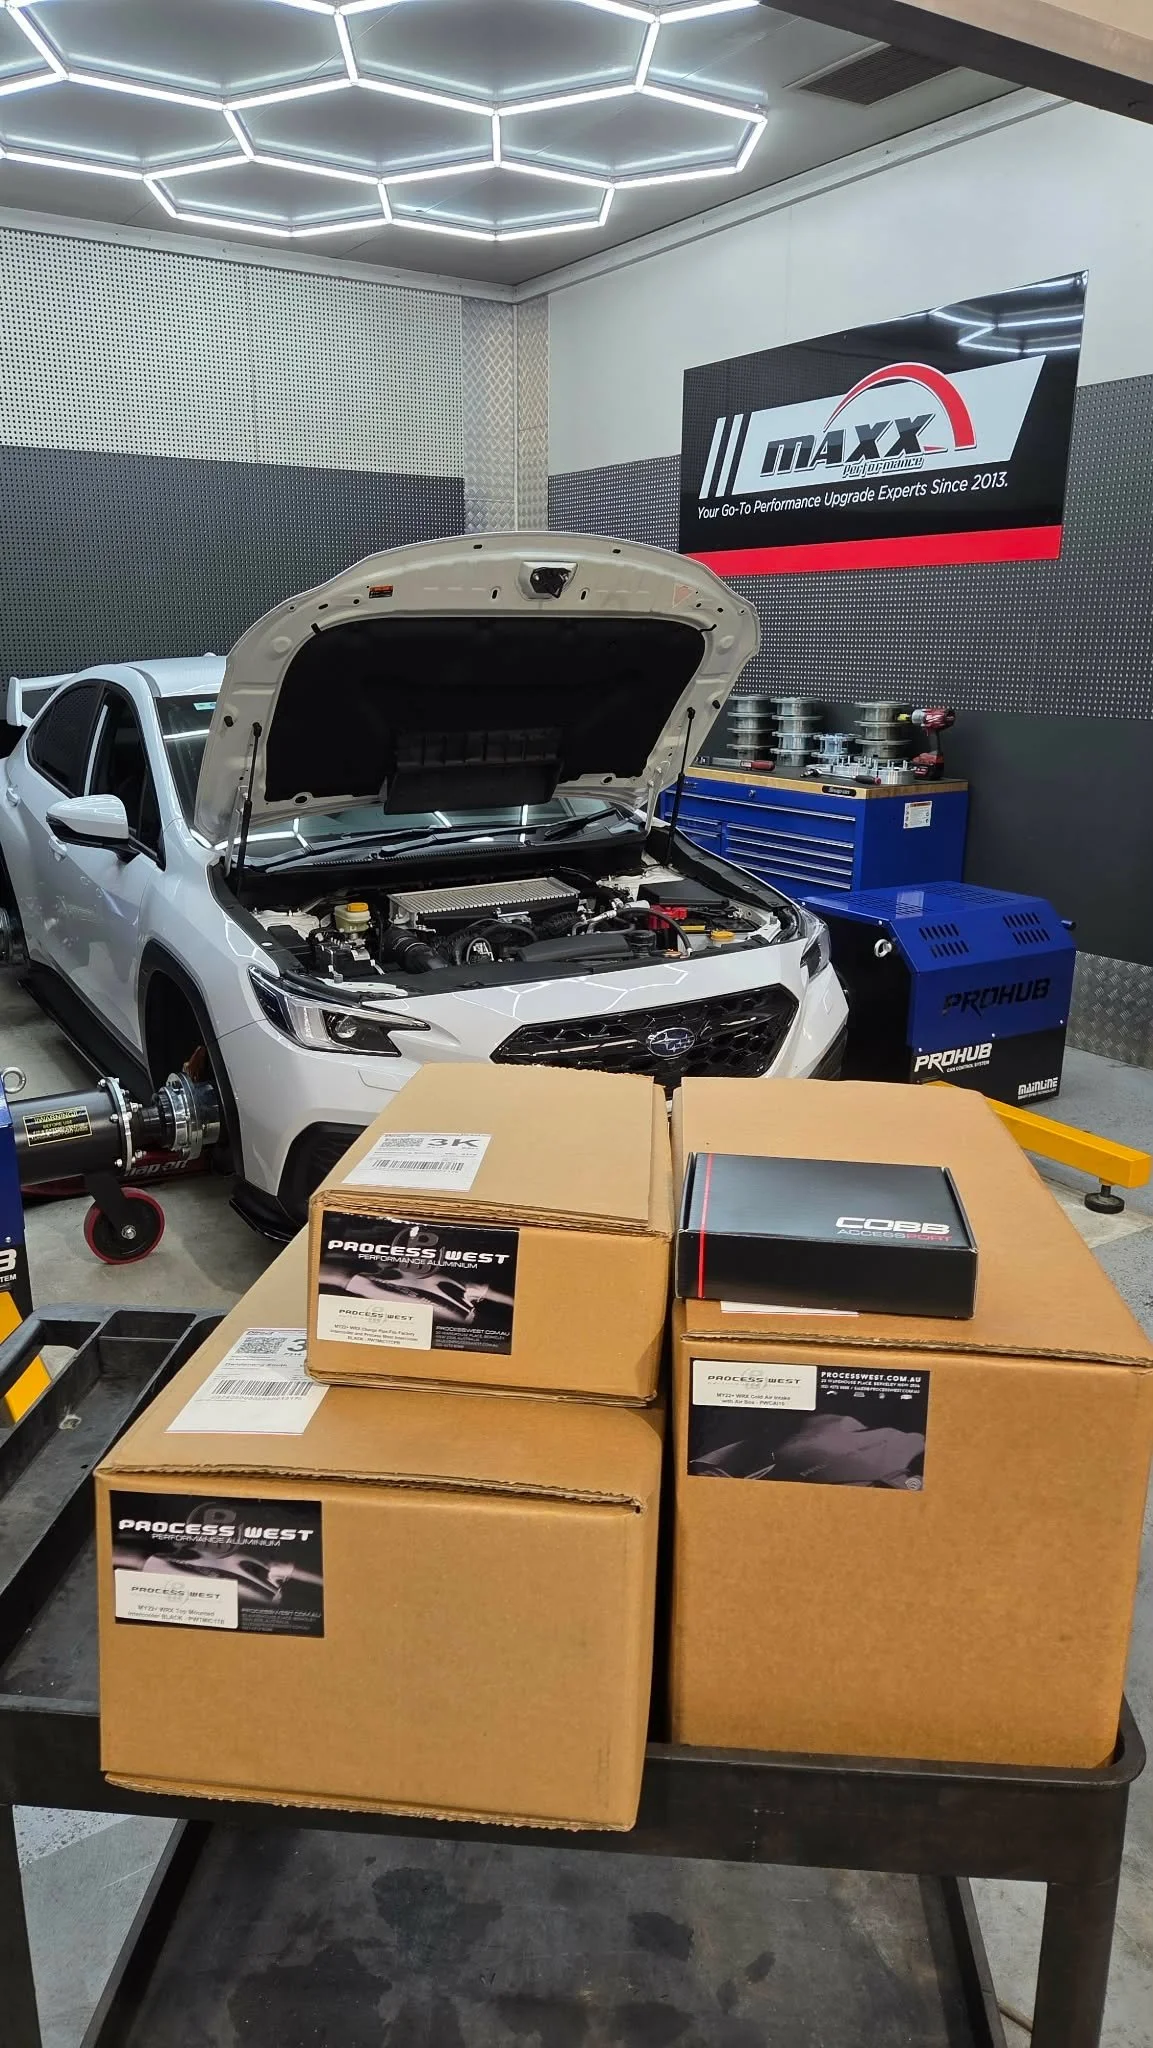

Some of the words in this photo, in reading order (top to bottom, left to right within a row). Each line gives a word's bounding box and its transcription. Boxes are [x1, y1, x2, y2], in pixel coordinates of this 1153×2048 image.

[760, 413, 935, 477] MAXX
[843, 456, 924, 478] Performance
[698, 506, 719, 520] Your
[721, 502, 751, 517] Go-To
[753, 496, 820, 514] Performance
[824, 487, 875, 508] Upgrade
[878, 481, 928, 501] Experts
[931, 478, 968, 495] Since
[971, 471, 1008, 491] 2013.
[942, 977, 1051, 1017] PROHUB
[913, 1042, 993, 1073] PROHUB
[427, 1138, 480, 1148] 3K
[124, 1160, 188, 1176] nap-on
[835, 1216, 950, 1235] COBB
[836, 1228, 953, 1242] ACCESSPORT
[327, 1239, 437, 1259] PROCESS
[444, 1249, 511, 1265] WEST
[358, 1253, 426, 1265] PERFORMANCE
[427, 1259, 478, 1270] ALUMINIUM
[338, 1308, 384, 1319] PROCESS
[387, 1313, 415, 1321] WEST
[707, 1375, 764, 1383] PROCESS
[820, 1371, 922, 1383] PROCESSWEST.COM.AU
[118, 1519, 236, 1537] PROCESS
[244, 1526, 314, 1542] WEST
[151, 1533, 225, 1545] PERFORMANCE
[225, 1536, 281, 1547] ALUMINIUM
[130, 1586, 185, 1597] PROCESS
[189, 1591, 221, 1600] WEST
